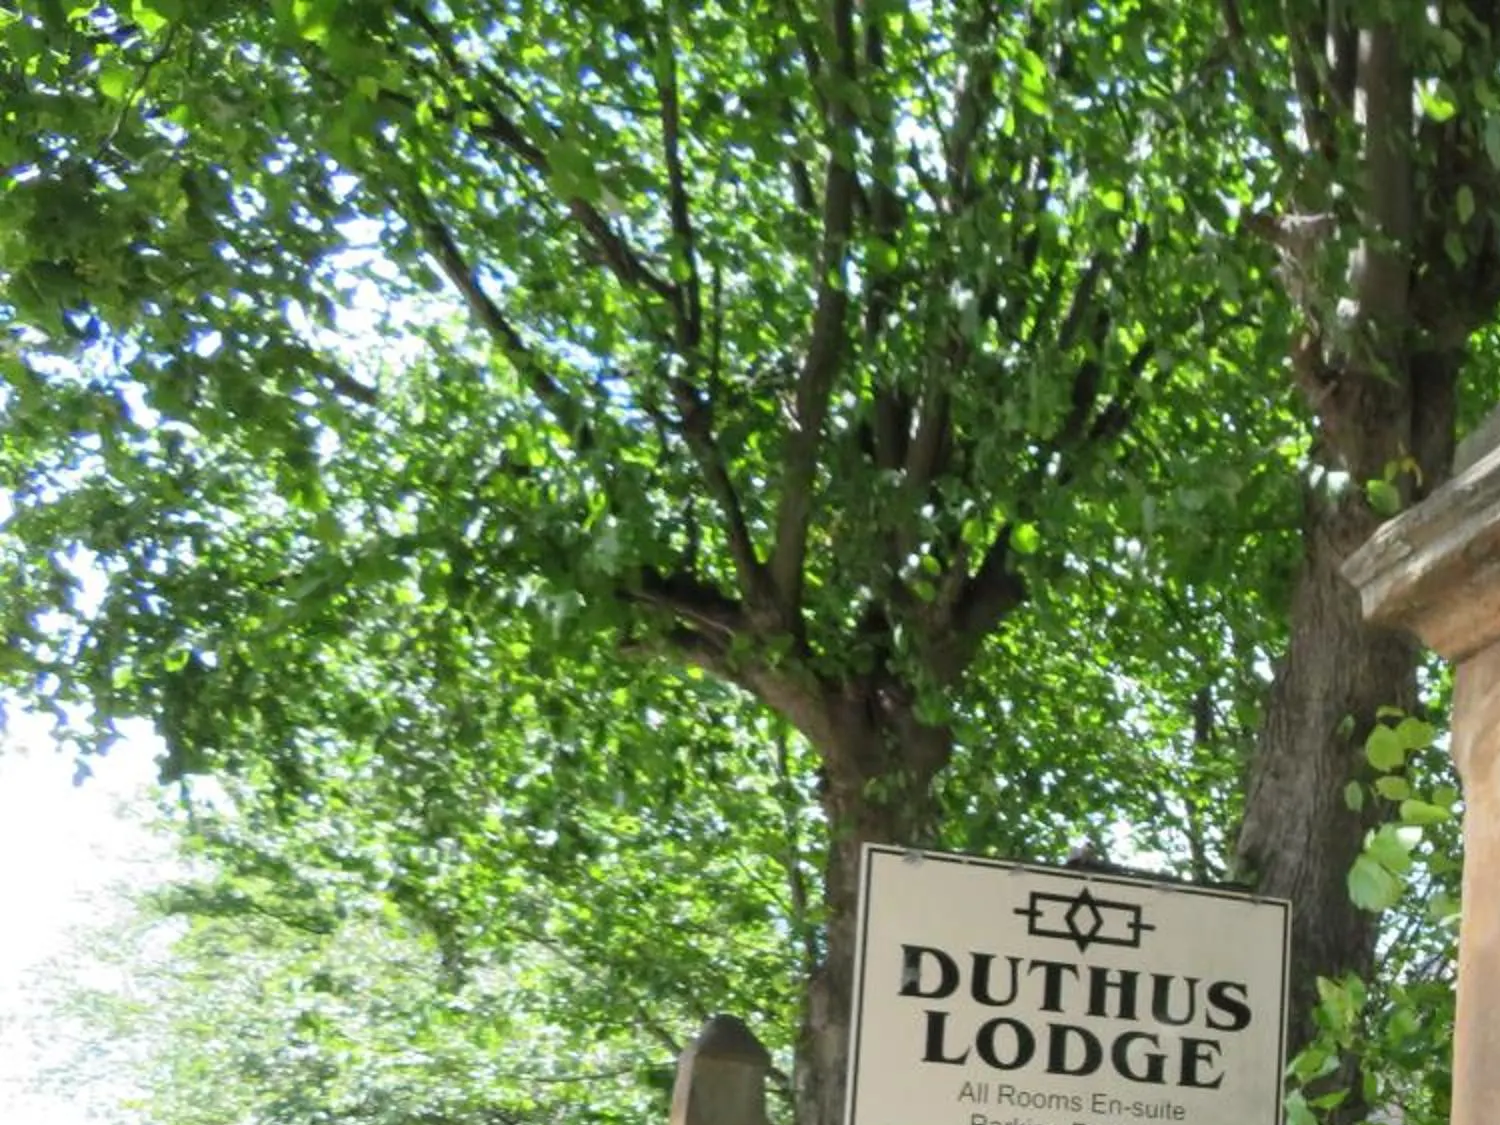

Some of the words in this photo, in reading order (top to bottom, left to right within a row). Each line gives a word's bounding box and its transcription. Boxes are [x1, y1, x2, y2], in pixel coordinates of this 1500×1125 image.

[898, 944, 1252, 1032] DUTHUS
[921, 1010, 1225, 1090] LODGE
[958, 1081, 989, 1104] All
[997, 1084, 1083, 1112] Rooms
[1091, 1093, 1187, 1120] En-suite
